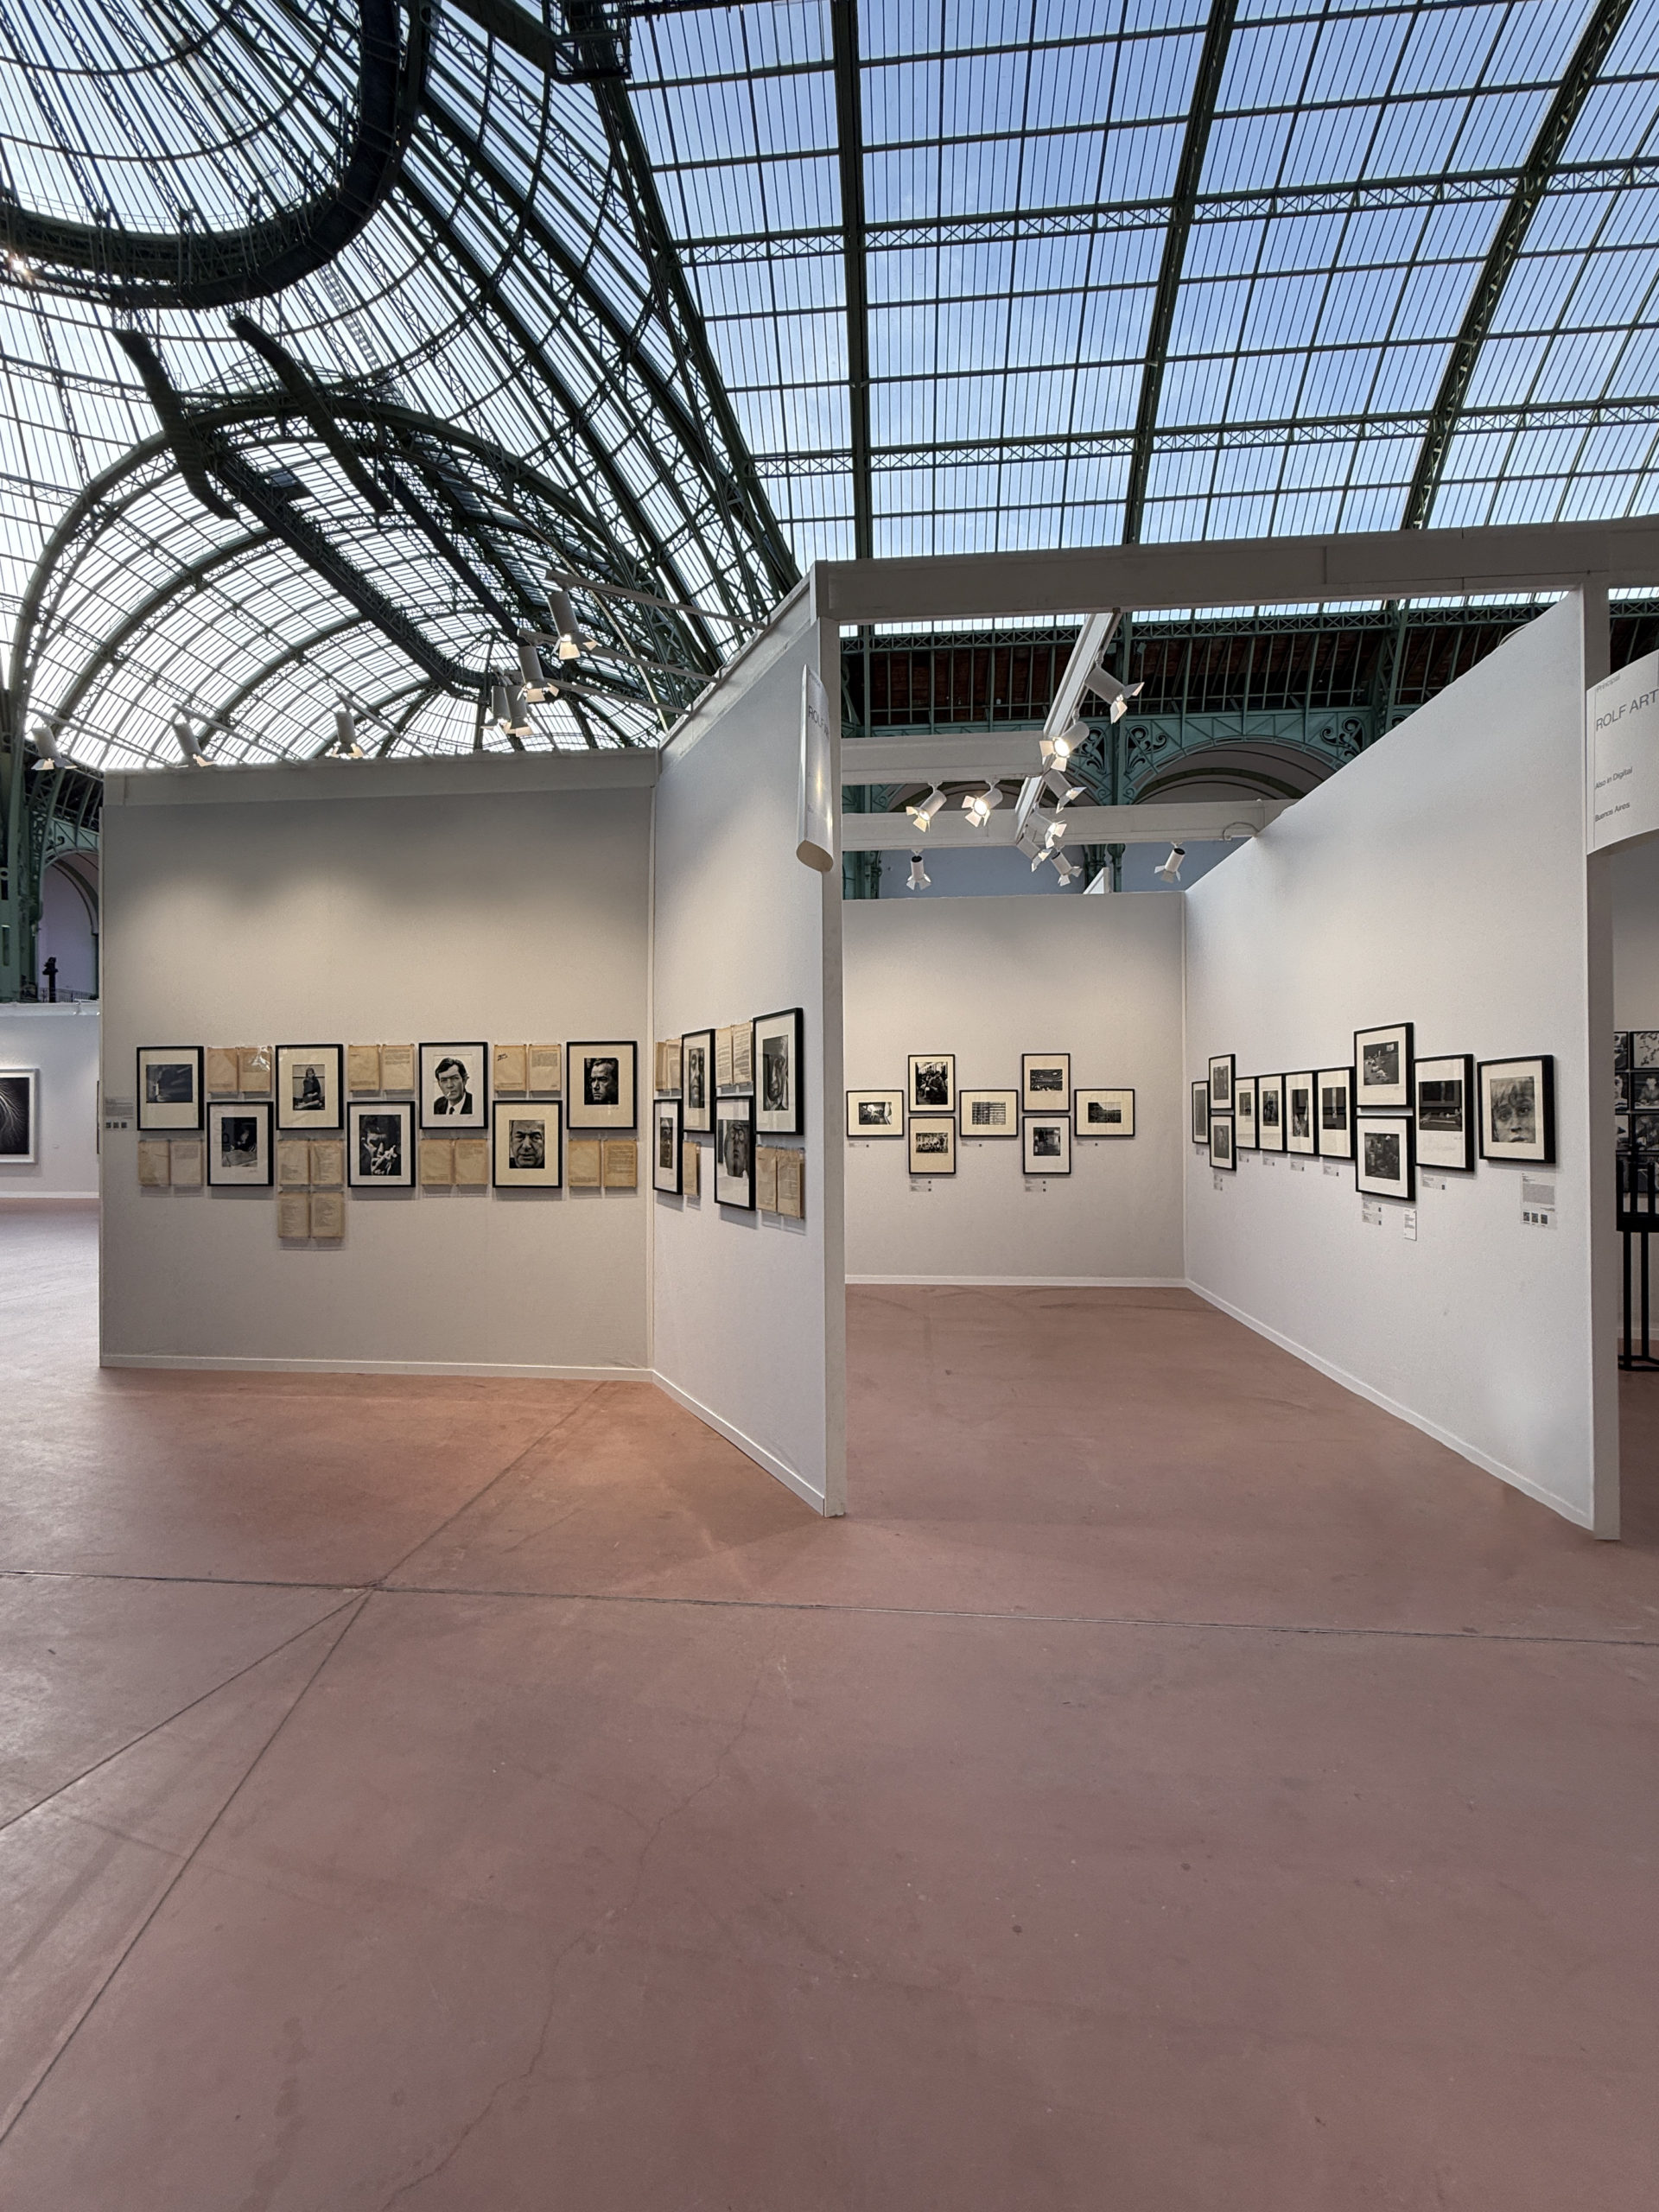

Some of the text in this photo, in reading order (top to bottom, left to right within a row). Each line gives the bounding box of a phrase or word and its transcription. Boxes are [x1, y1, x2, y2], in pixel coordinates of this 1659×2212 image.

[1596, 689, 1659, 732] ROLF ART
[1595, 780, 1606, 790] Also
[1613, 766, 1632, 780] Digital
[1595, 802, 1630, 822] Buenos Aires
